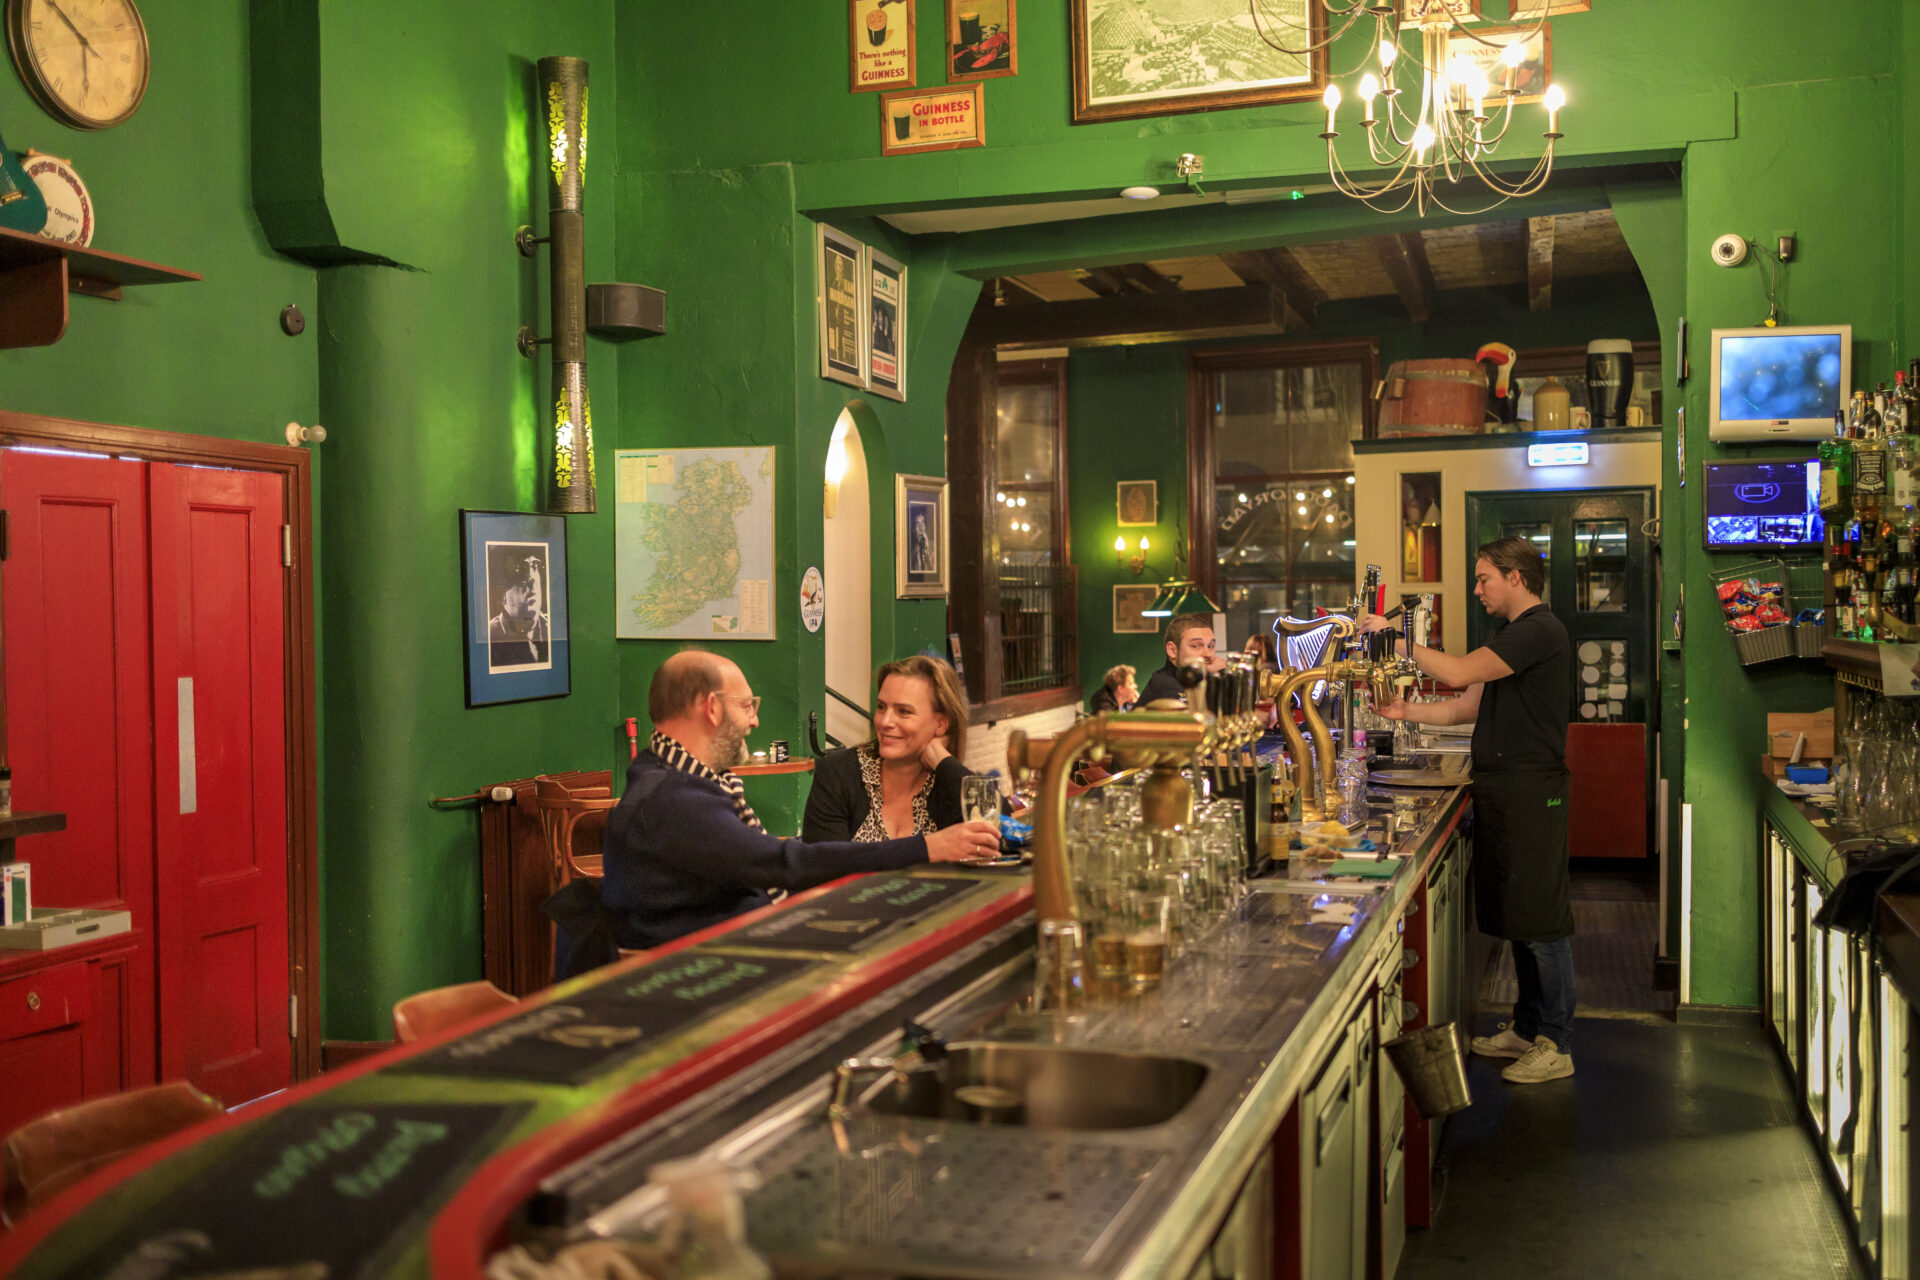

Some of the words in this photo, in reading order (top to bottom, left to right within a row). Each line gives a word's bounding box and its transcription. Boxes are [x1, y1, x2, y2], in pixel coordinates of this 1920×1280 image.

[859, 50, 881, 60] There's
[882, 48, 906, 59] nothing
[862, 68, 905, 81] GUINNESS
[912, 100, 970, 117] GUINNESS
[919, 118, 929, 128] IN
[931, 114, 965, 126] BOTTLE
[54, 207, 79, 224] Olympics
[1589, 379, 1621, 388] GUINNESS
[803, 609, 822, 619] GUINNESS
